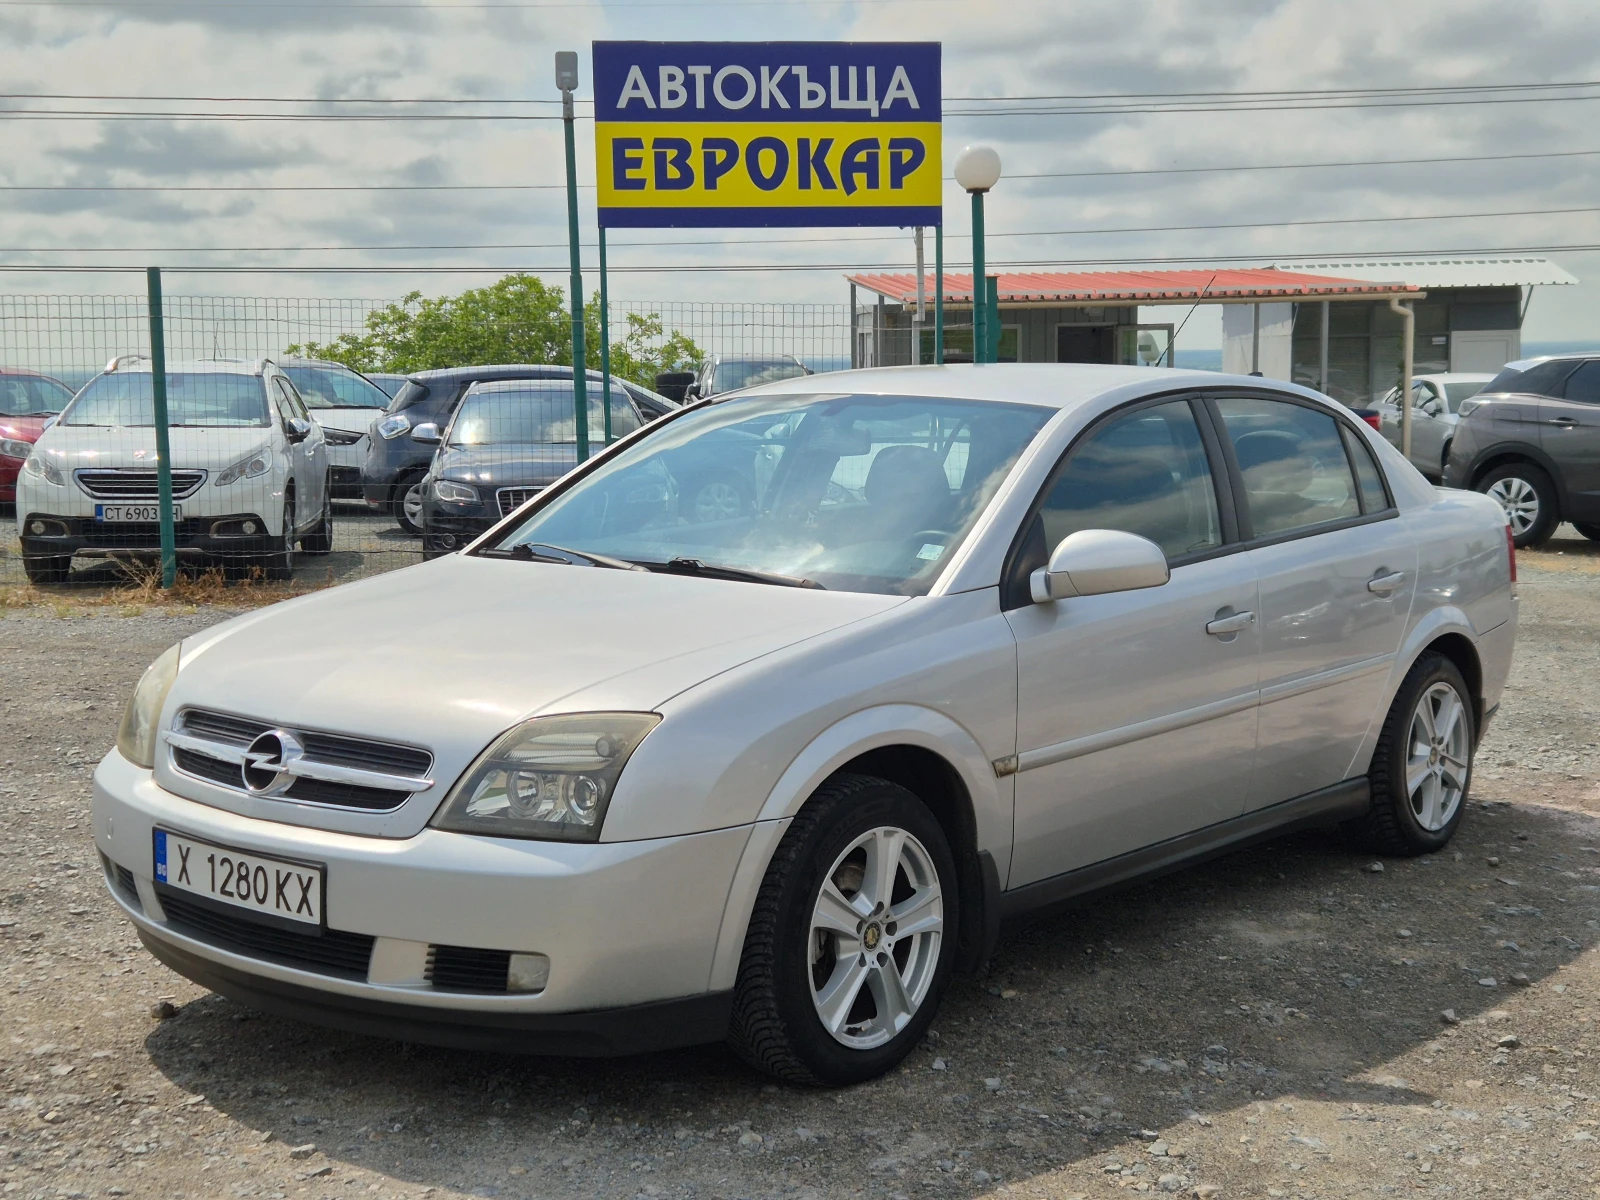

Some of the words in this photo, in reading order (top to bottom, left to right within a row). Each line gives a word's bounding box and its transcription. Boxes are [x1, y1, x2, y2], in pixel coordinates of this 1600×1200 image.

[616, 65, 921, 118] АВТОКЪЩА
[612, 136, 926, 197] ЕВРОКАР
[156, 862, 167, 877] BG
